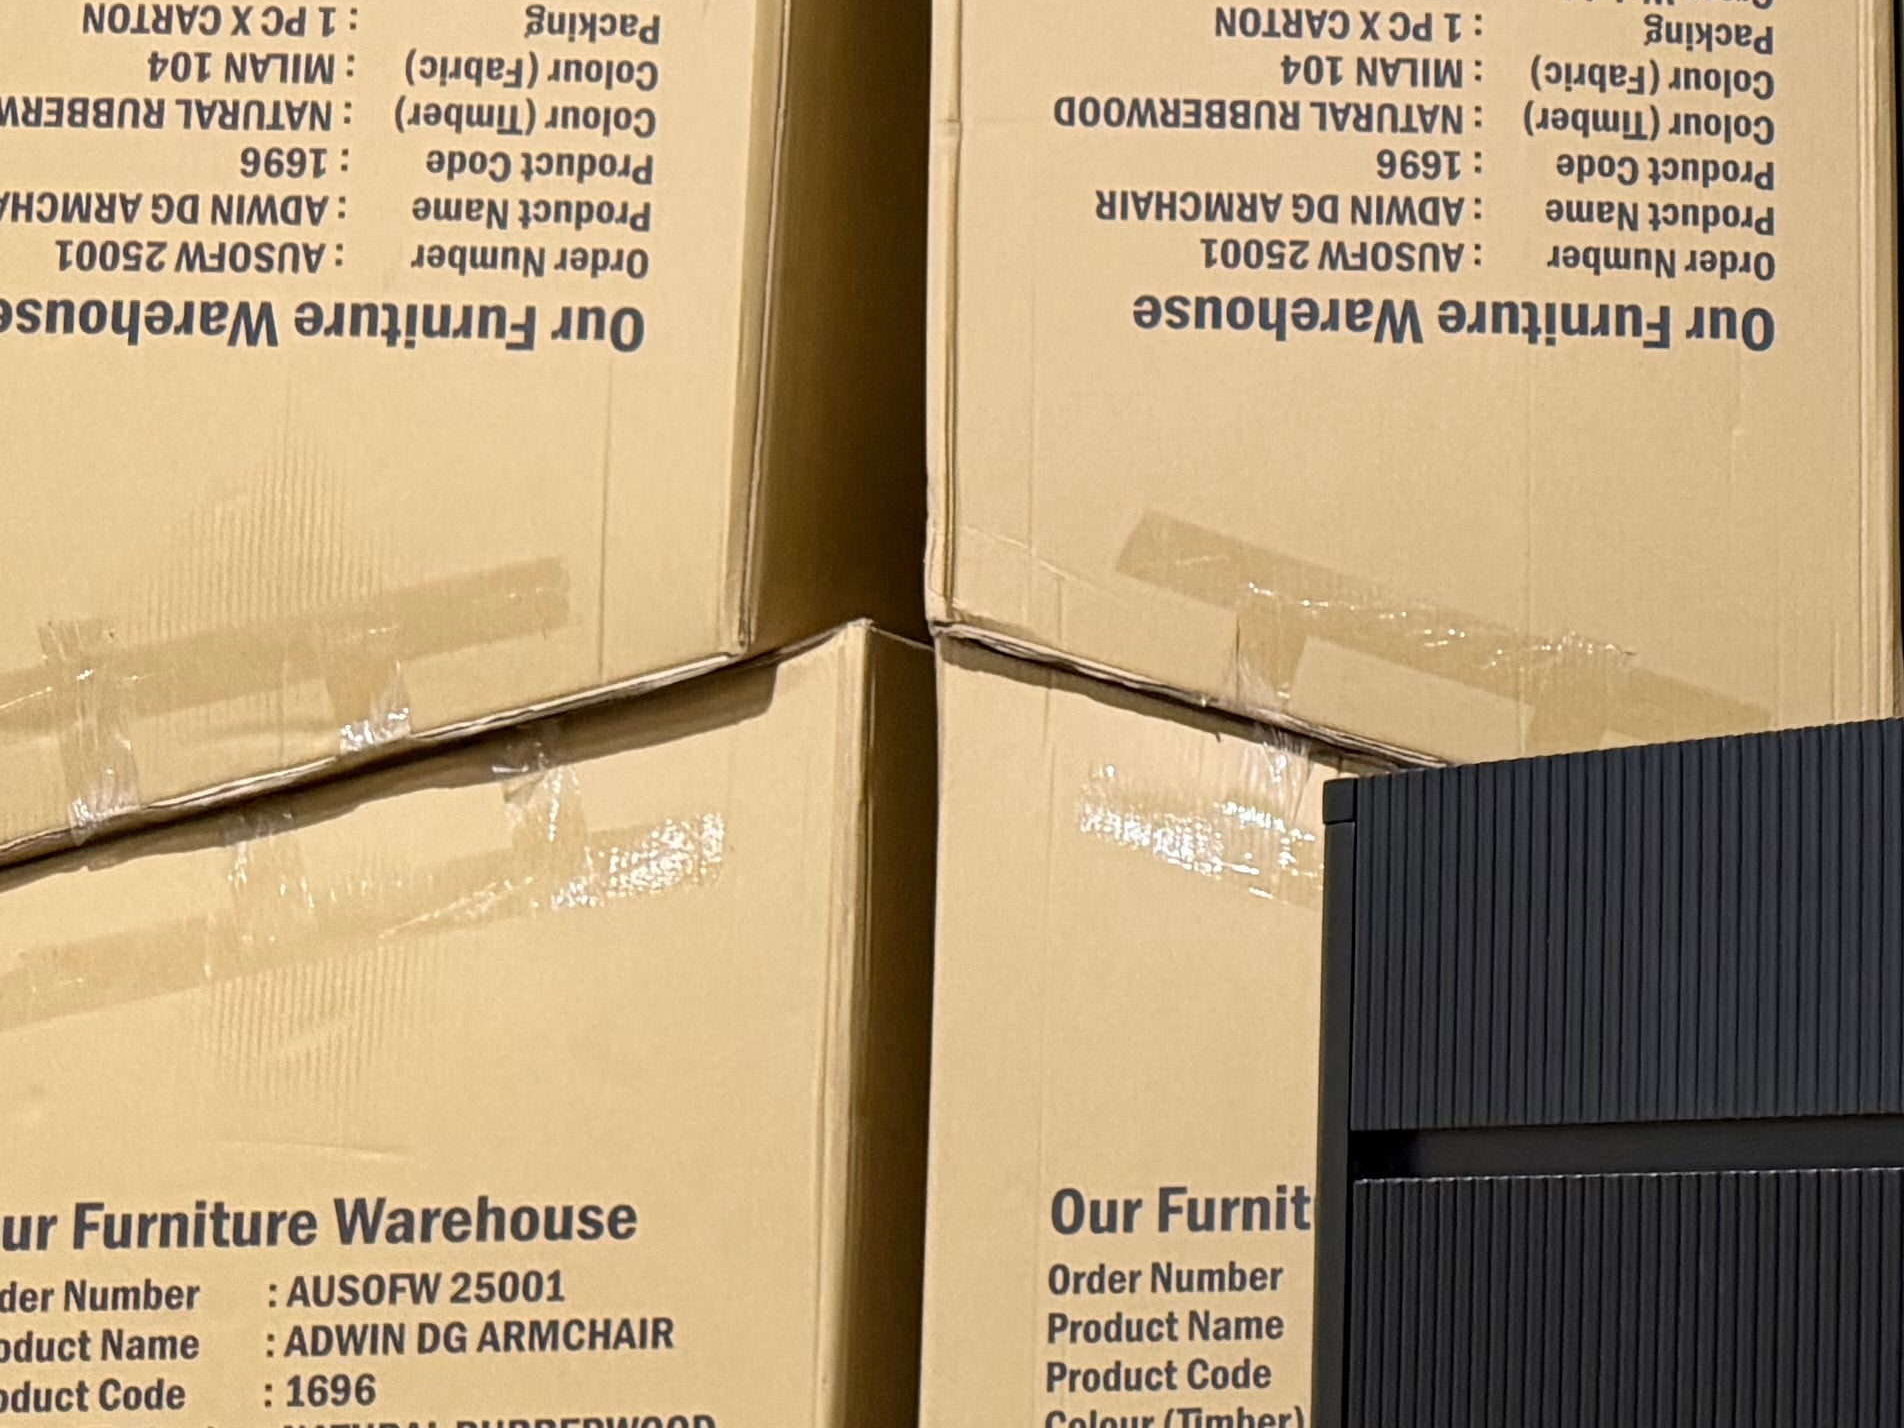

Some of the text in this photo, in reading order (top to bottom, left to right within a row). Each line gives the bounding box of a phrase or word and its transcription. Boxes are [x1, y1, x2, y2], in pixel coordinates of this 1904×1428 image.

[1215, 7, 1773, 55] Packing 1 PC X CARTON
[148, 48, 658, 91] Colour (Fabric) MILAN 104
[1054, 96, 1774, 146] Colour (Timber) NATURAL RUBBERWOOD
[240, 147, 653, 185] Product Code 1696
[1096, 190, 1774, 236] Product Name ADWIN DG ARMCHAIR
[55, 240, 649, 279] Order Number AUSOFW 25001
[1200, 238, 1775, 281] Order Number AUSOFW 25001
[294, 301, 536, 351] Furniture
[551, 306, 644, 353] Our
[1133, 295, 1774, 351] Our Furniture Warehouse
[2, 1195, 637, 1252] ur Furniture Warehouse
[1051, 1184, 1311, 1235] Our Furnit
[0, 1269, 565, 1314] der Number AUSOFW 25001
[1048, 1260, 1284, 1295] Order Number
[0, 1317, 674, 1363] oduct Name ADWIN DG ARMCHAIR
[1047, 1309, 1284, 1344] Product Name
